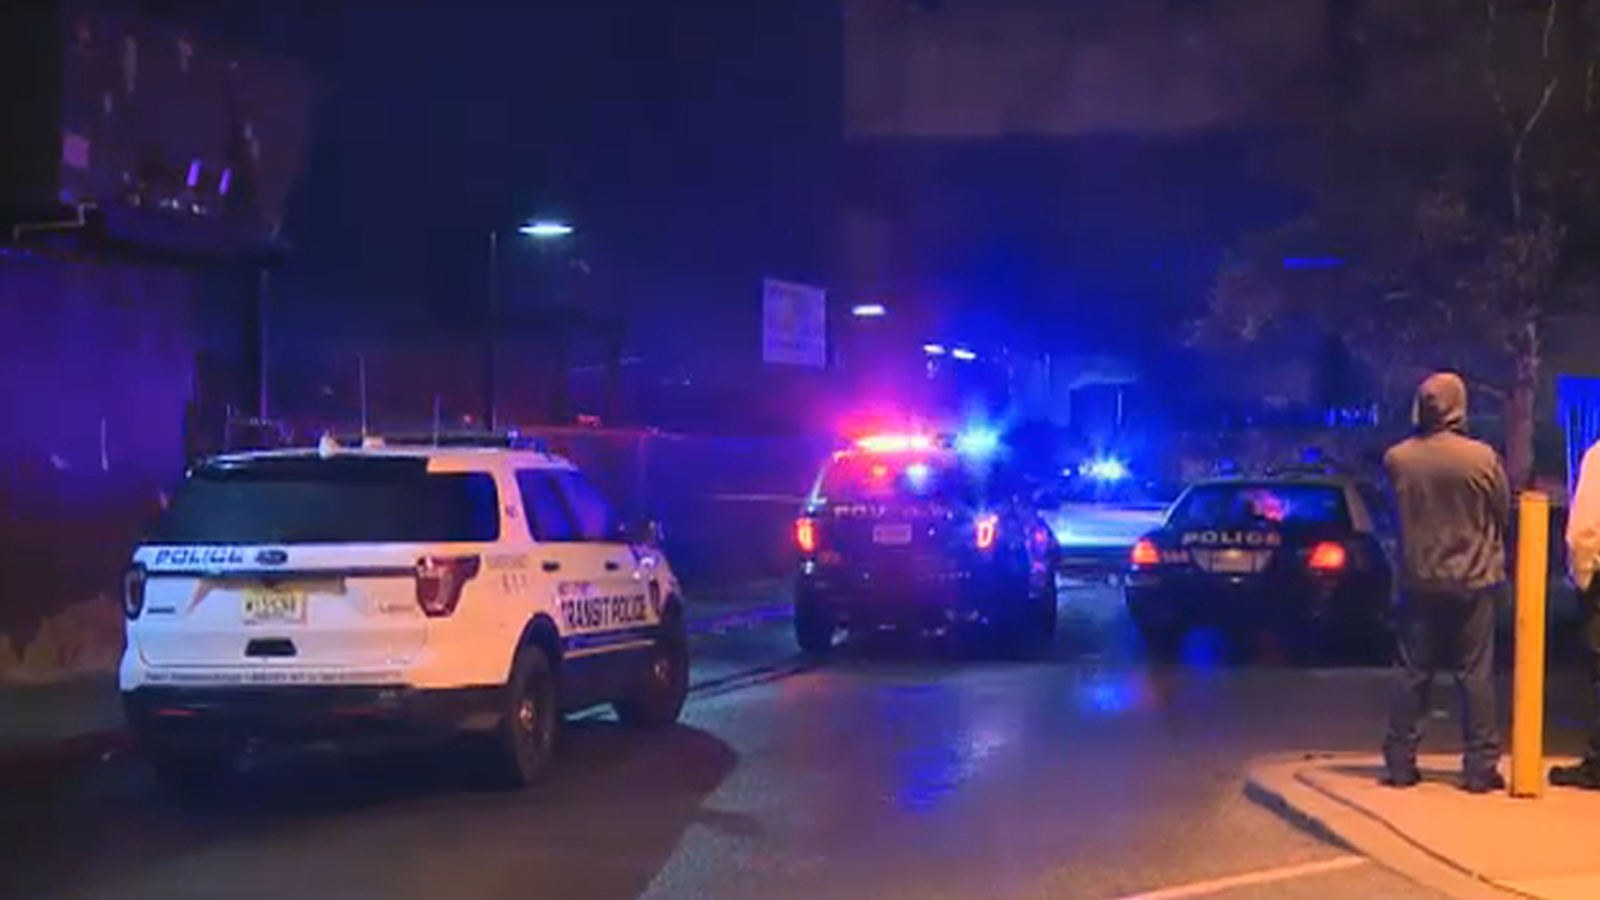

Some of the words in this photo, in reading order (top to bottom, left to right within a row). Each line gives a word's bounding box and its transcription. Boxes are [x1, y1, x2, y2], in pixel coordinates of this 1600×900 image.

[1181, 530, 1281, 546] POLICE
[155, 549, 244, 565] POLICE
[560, 596, 610, 628] TRANSIT
[612, 592, 648, 623] POLICE
